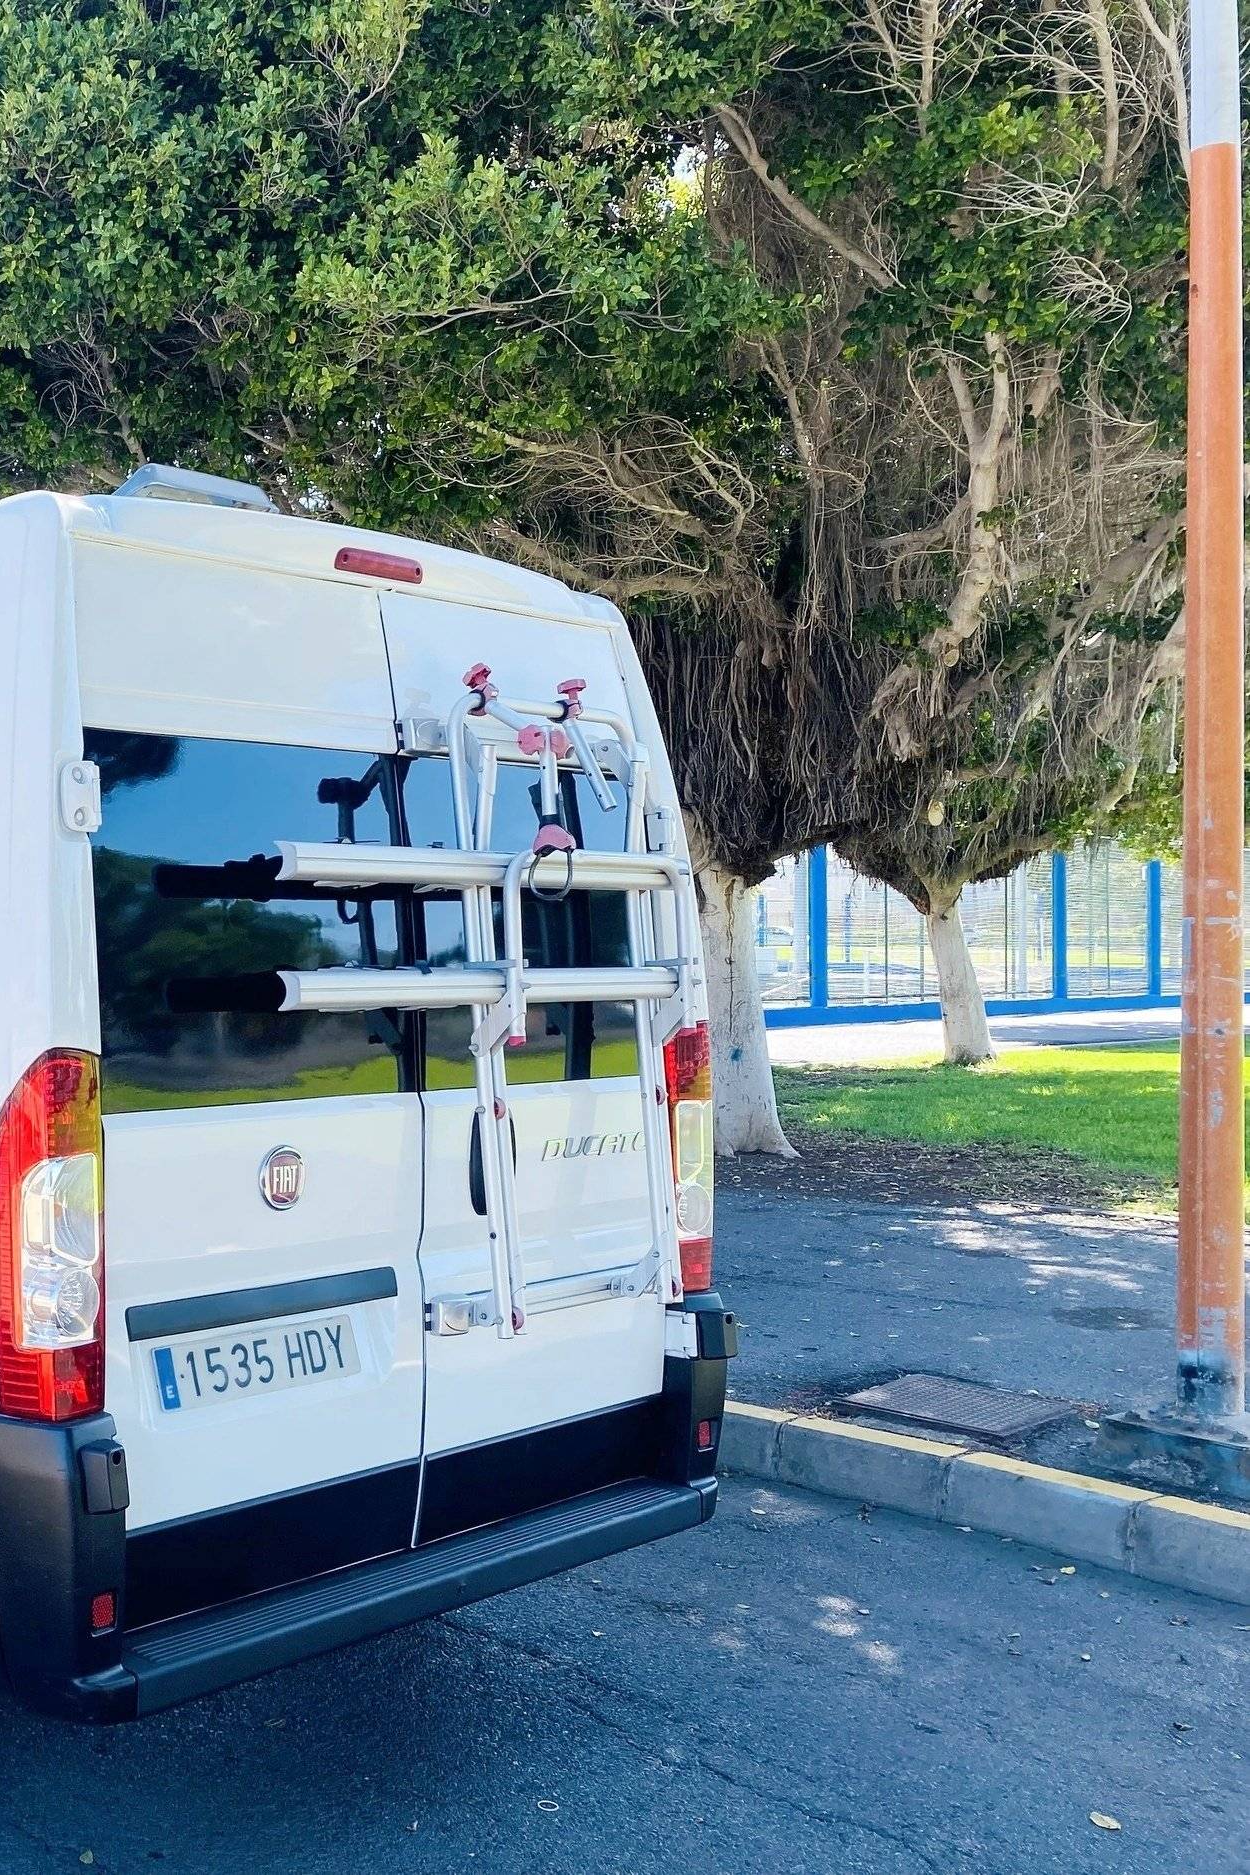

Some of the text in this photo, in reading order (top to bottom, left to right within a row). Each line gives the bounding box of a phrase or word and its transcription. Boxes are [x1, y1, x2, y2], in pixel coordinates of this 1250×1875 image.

[272, 1164, 298, 1194] FIAT
[186, 1324, 344, 1397] 1535 HDY
[166, 1385, 175, 1399] E
